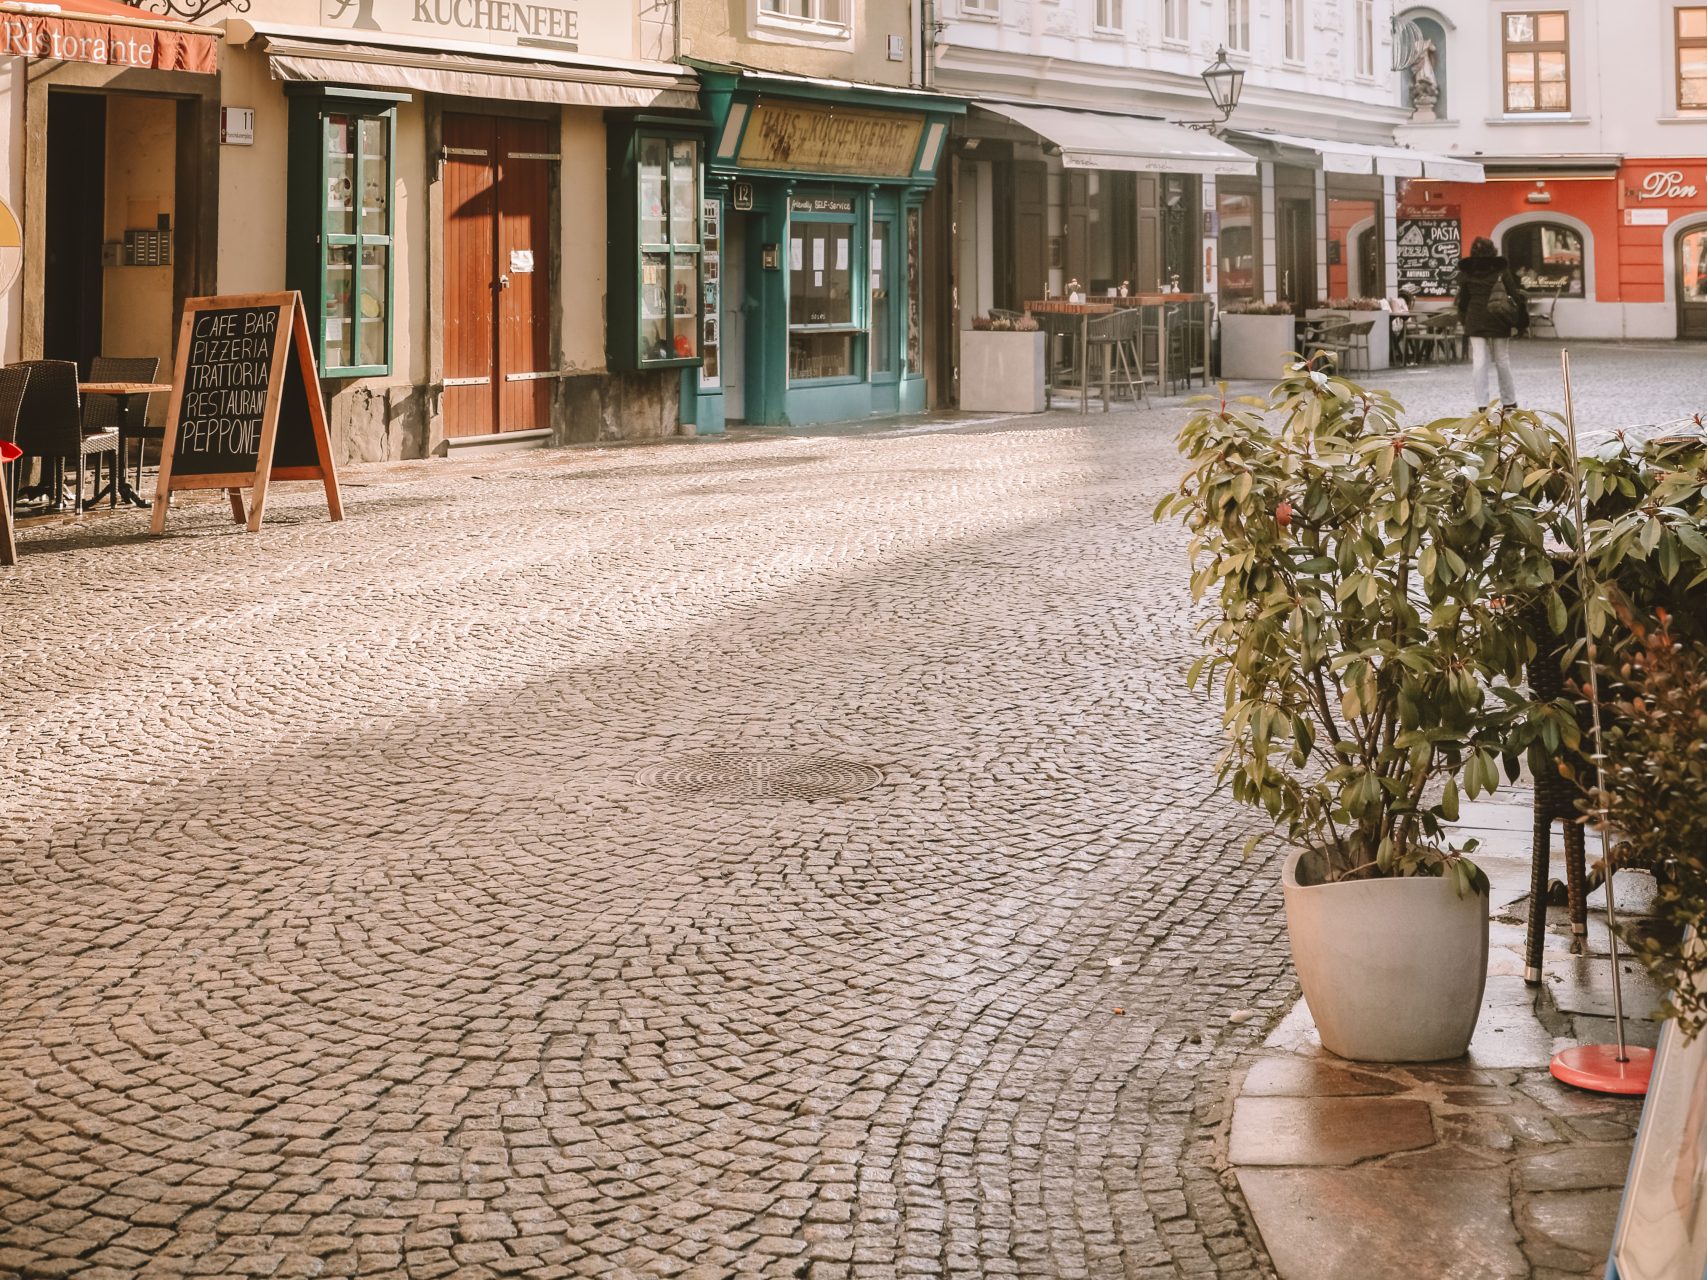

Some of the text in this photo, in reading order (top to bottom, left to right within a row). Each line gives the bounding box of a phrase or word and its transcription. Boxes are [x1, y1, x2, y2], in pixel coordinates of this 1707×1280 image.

[3, 21, 152, 65] Ristorante
[243, 111, 254, 130] 11
[738, 184, 750, 201] 12
[1640, 171, 1698, 198] Don
[791, 199, 812, 213] friendly
[1431, 227, 1460, 241] PASTA
[195, 311, 276, 338] CAFE BAR
[192, 337, 269, 364] PIZZERIA
[190, 361, 269, 390] TRATTORIA
[181, 418, 263, 455] PEPPONE
